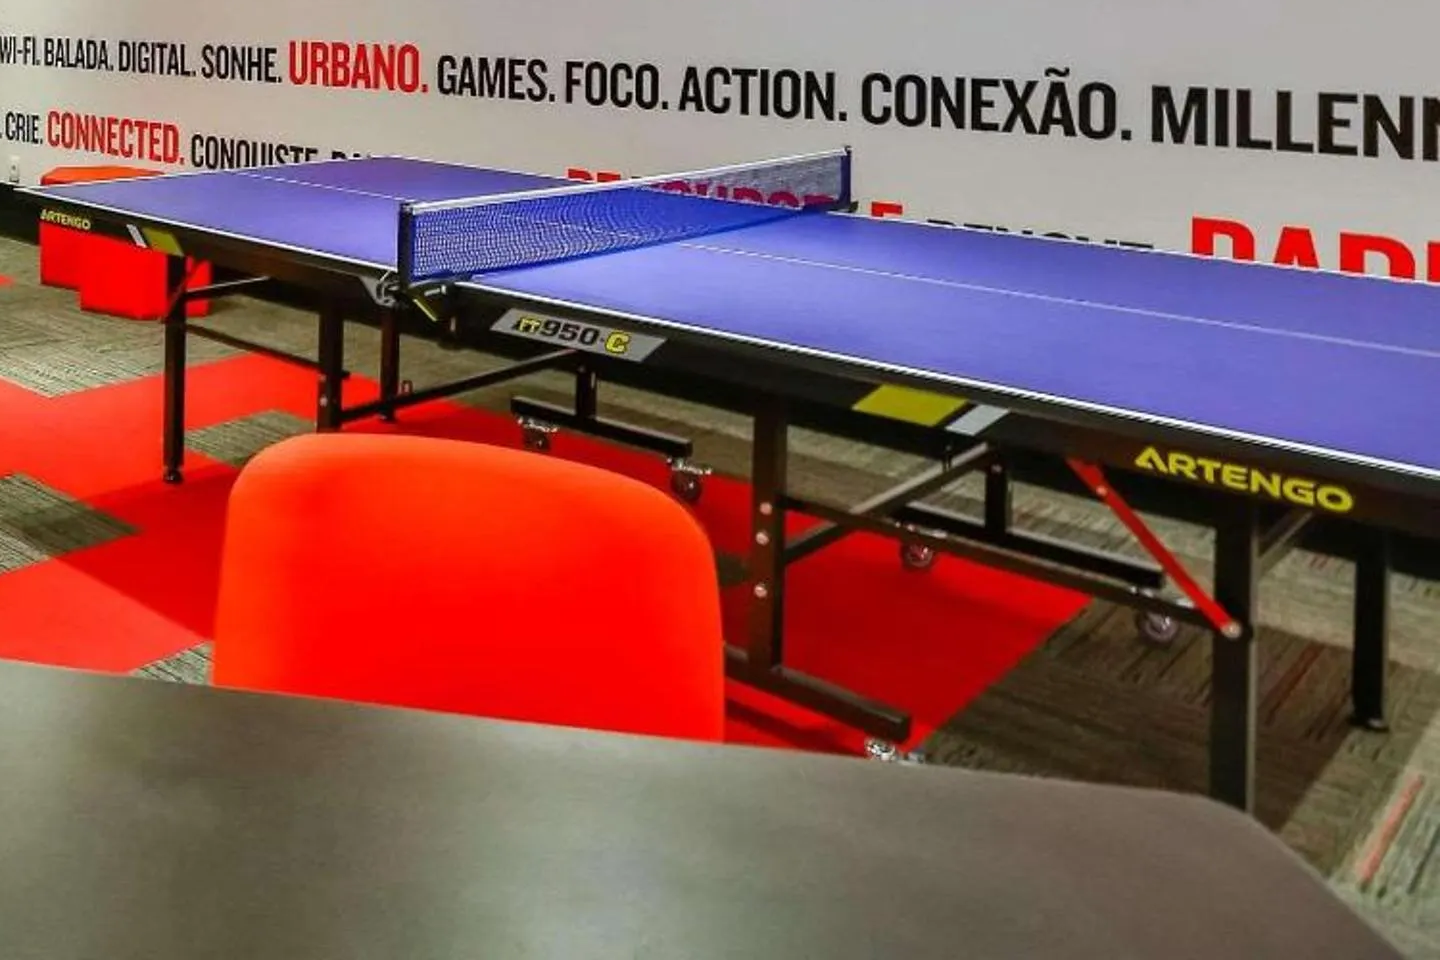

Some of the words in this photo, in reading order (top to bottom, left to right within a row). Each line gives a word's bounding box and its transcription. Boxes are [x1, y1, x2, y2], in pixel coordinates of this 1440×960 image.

[43, 37, 113, 71] BALADA.
[118, 40, 196, 77] DIGITAL.
[201, 45, 282, 83] SONHE.
[289, 40, 428, 93] URBANO.
[437, 55, 555, 102] GAMES.
[566, 61, 667, 111] FOCO.
[680, 66, 846, 121] ACTION.
[862, 67, 1131, 140] CONEXÃO.
[5, 111, 42, 144] CRIE.
[47, 110, 185, 165] CONNECTED.
[40, 208, 92, 230] ARTENGO
[1135, 446, 1354, 512] ARTENGO
